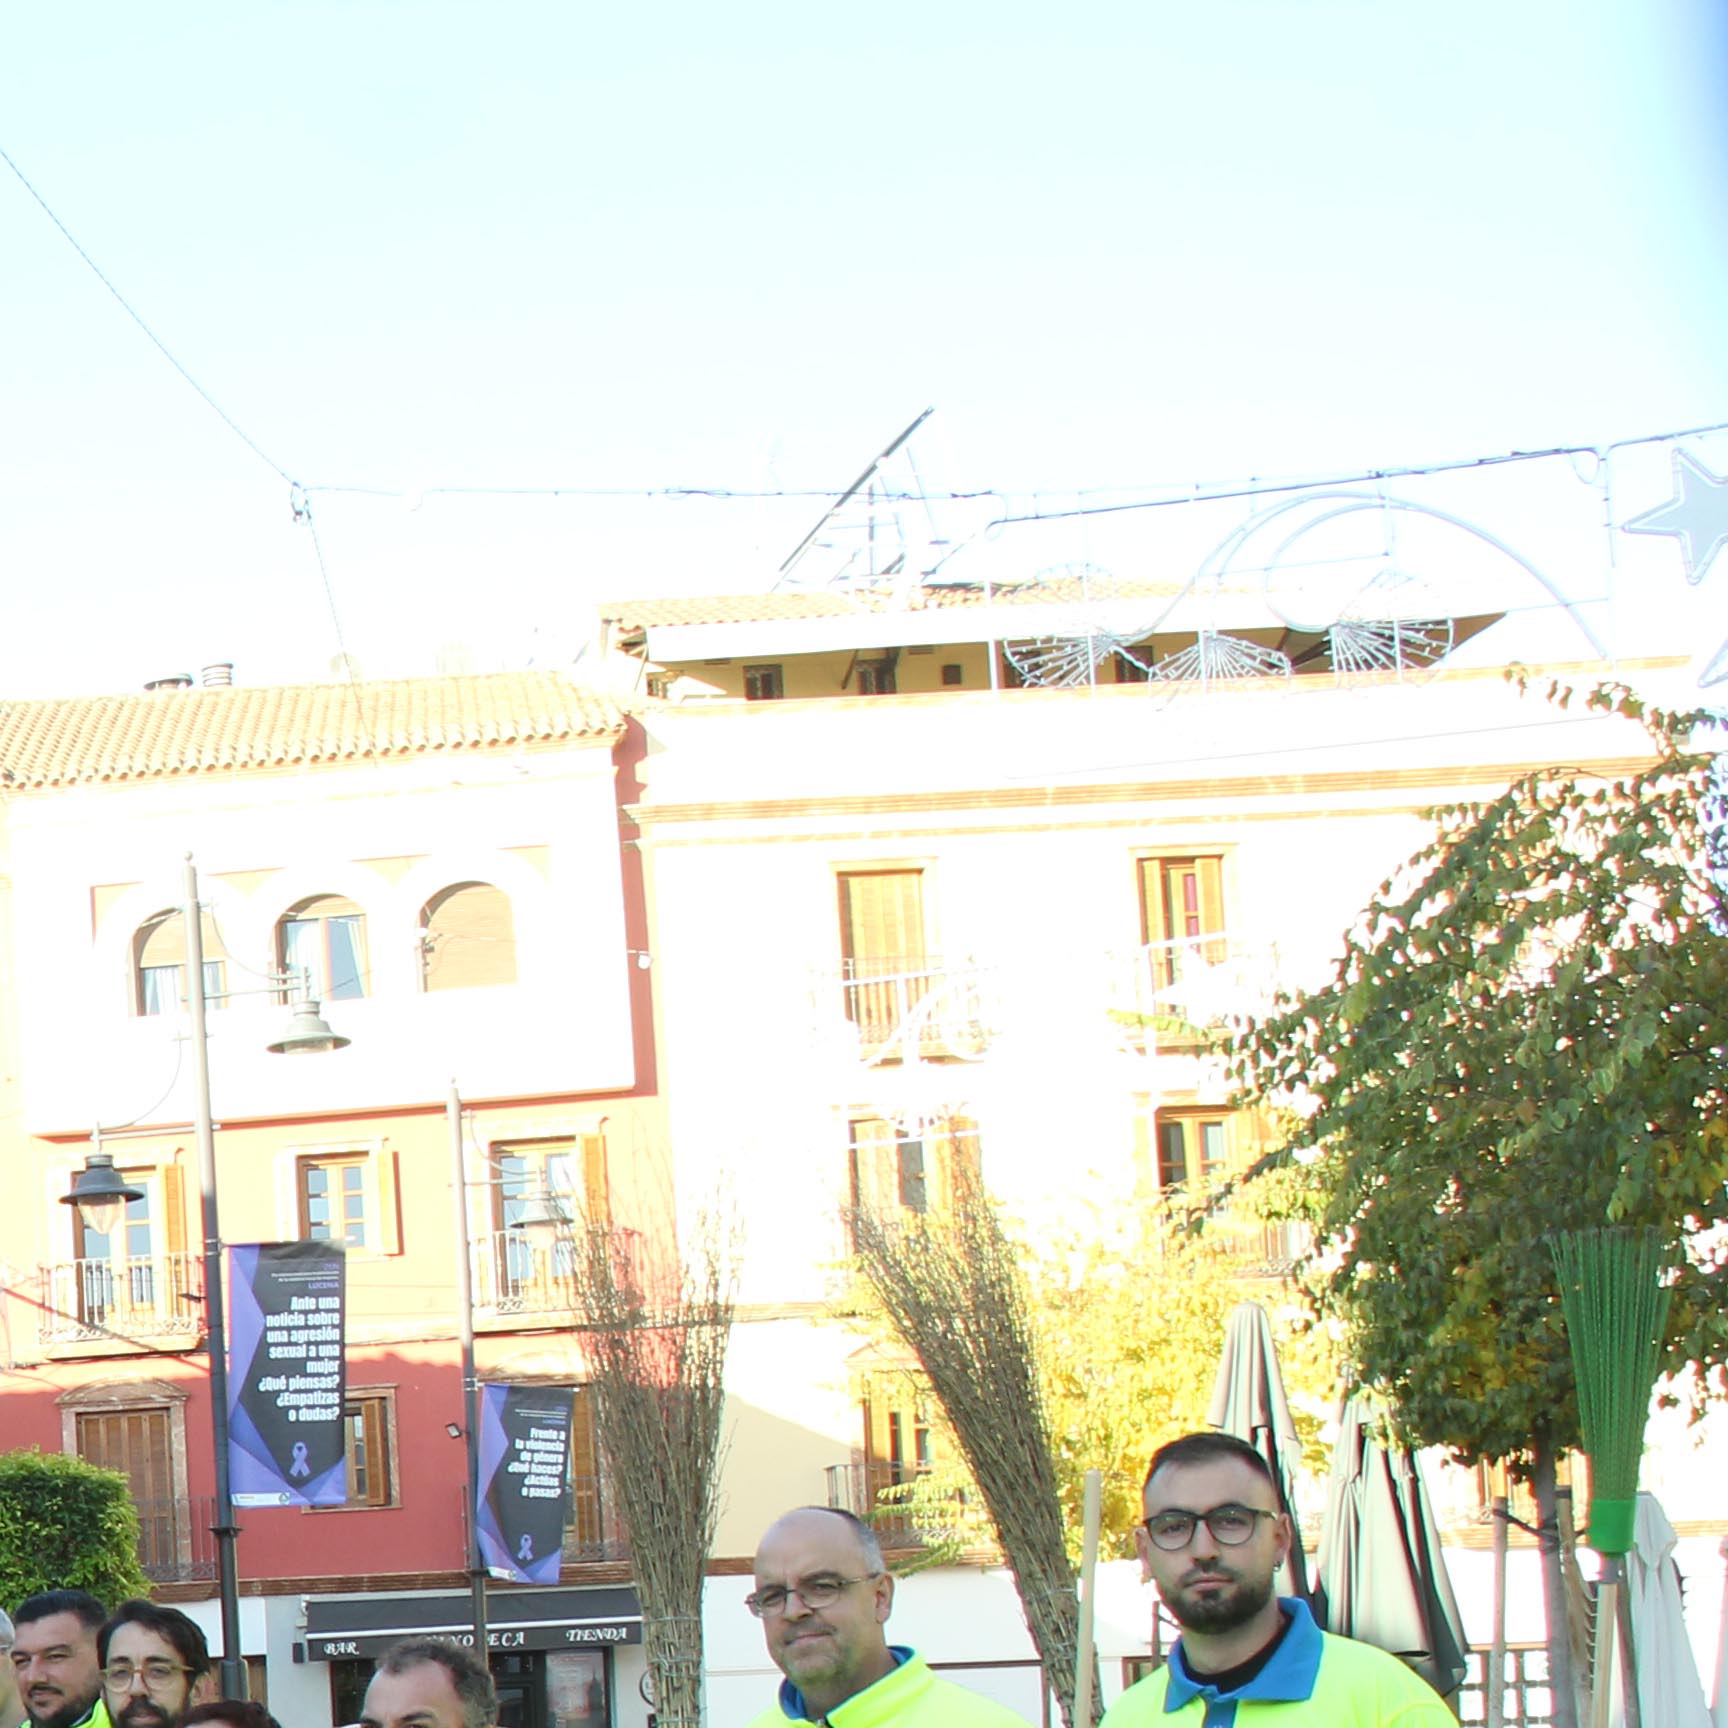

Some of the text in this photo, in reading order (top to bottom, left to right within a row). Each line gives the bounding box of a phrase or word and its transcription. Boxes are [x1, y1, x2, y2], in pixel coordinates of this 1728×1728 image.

[290, 1296, 340, 1311] Ante una
[266, 1312, 340, 1327] noticia sobre
[267, 1327, 340, 1343] una agresión
[269, 1344, 340, 1359] sexual a una
[306, 1360, 340, 1374] mujer
[258, 1375, 340, 1392] ¿Qué piensas?
[276, 1392, 340, 1407] ¿Empatizas
[288, 1407, 340, 1422] o dudas?
[530, 1427, 565, 1440] Frente a
[525, 1439, 565, 1452] violencia
[520, 1450, 564, 1463] de género
[323, 1641, 360, 1656] BAR
[565, 1627, 628, 1642] TIENDA
